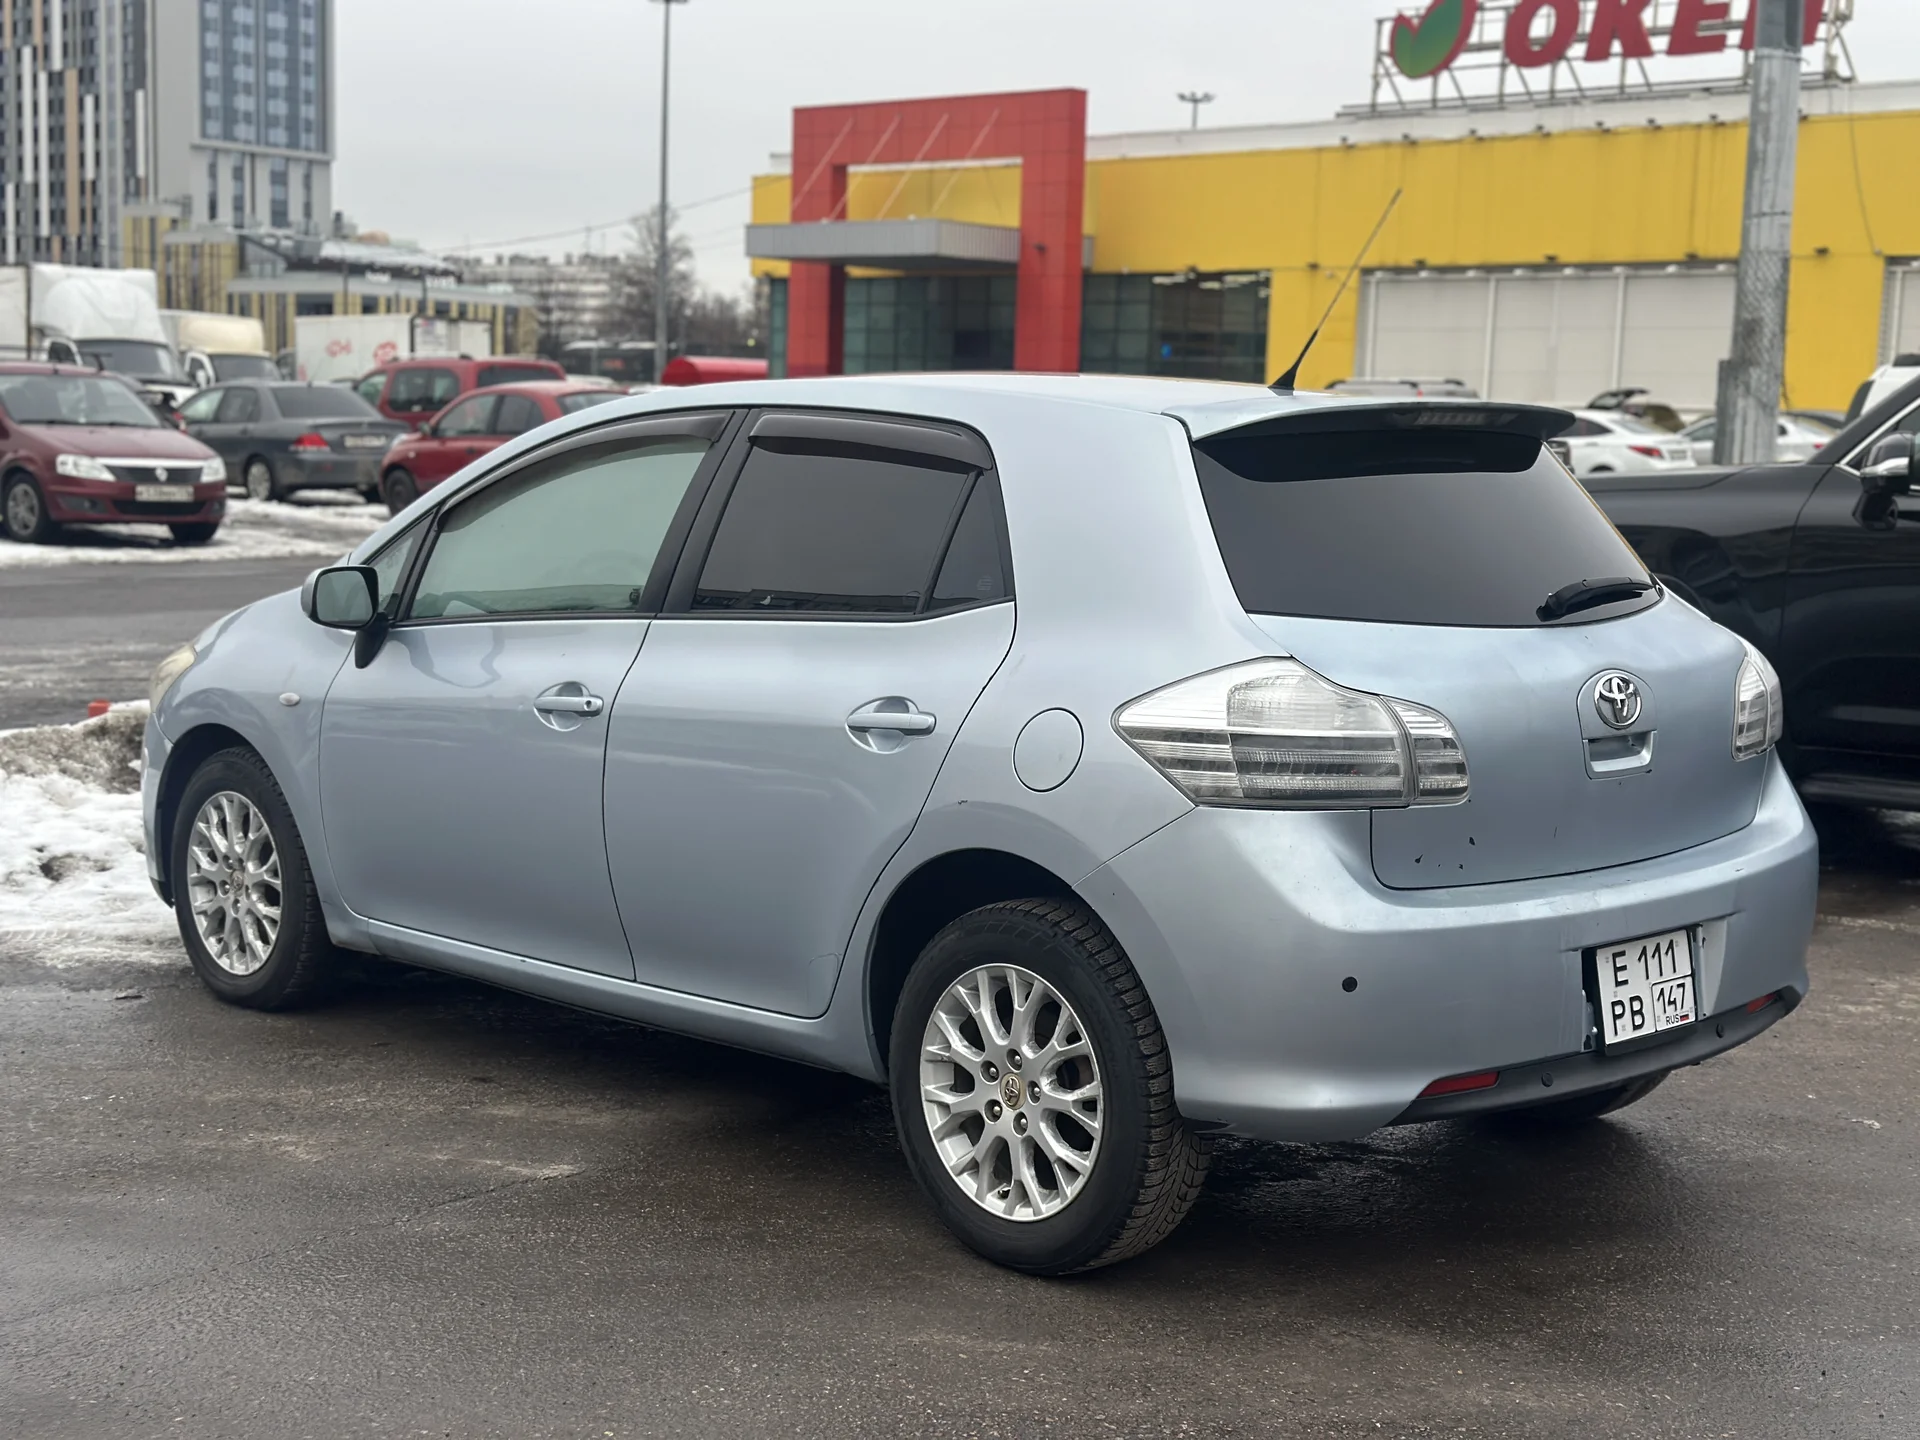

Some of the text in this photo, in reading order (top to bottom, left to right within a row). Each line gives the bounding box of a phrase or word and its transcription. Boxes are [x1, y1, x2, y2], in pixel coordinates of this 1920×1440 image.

[1612, 939, 1677, 987] Е 111
[1611, 982, 1686, 1036] РВ 147
[1665, 1013, 1680, 1025] RUS
